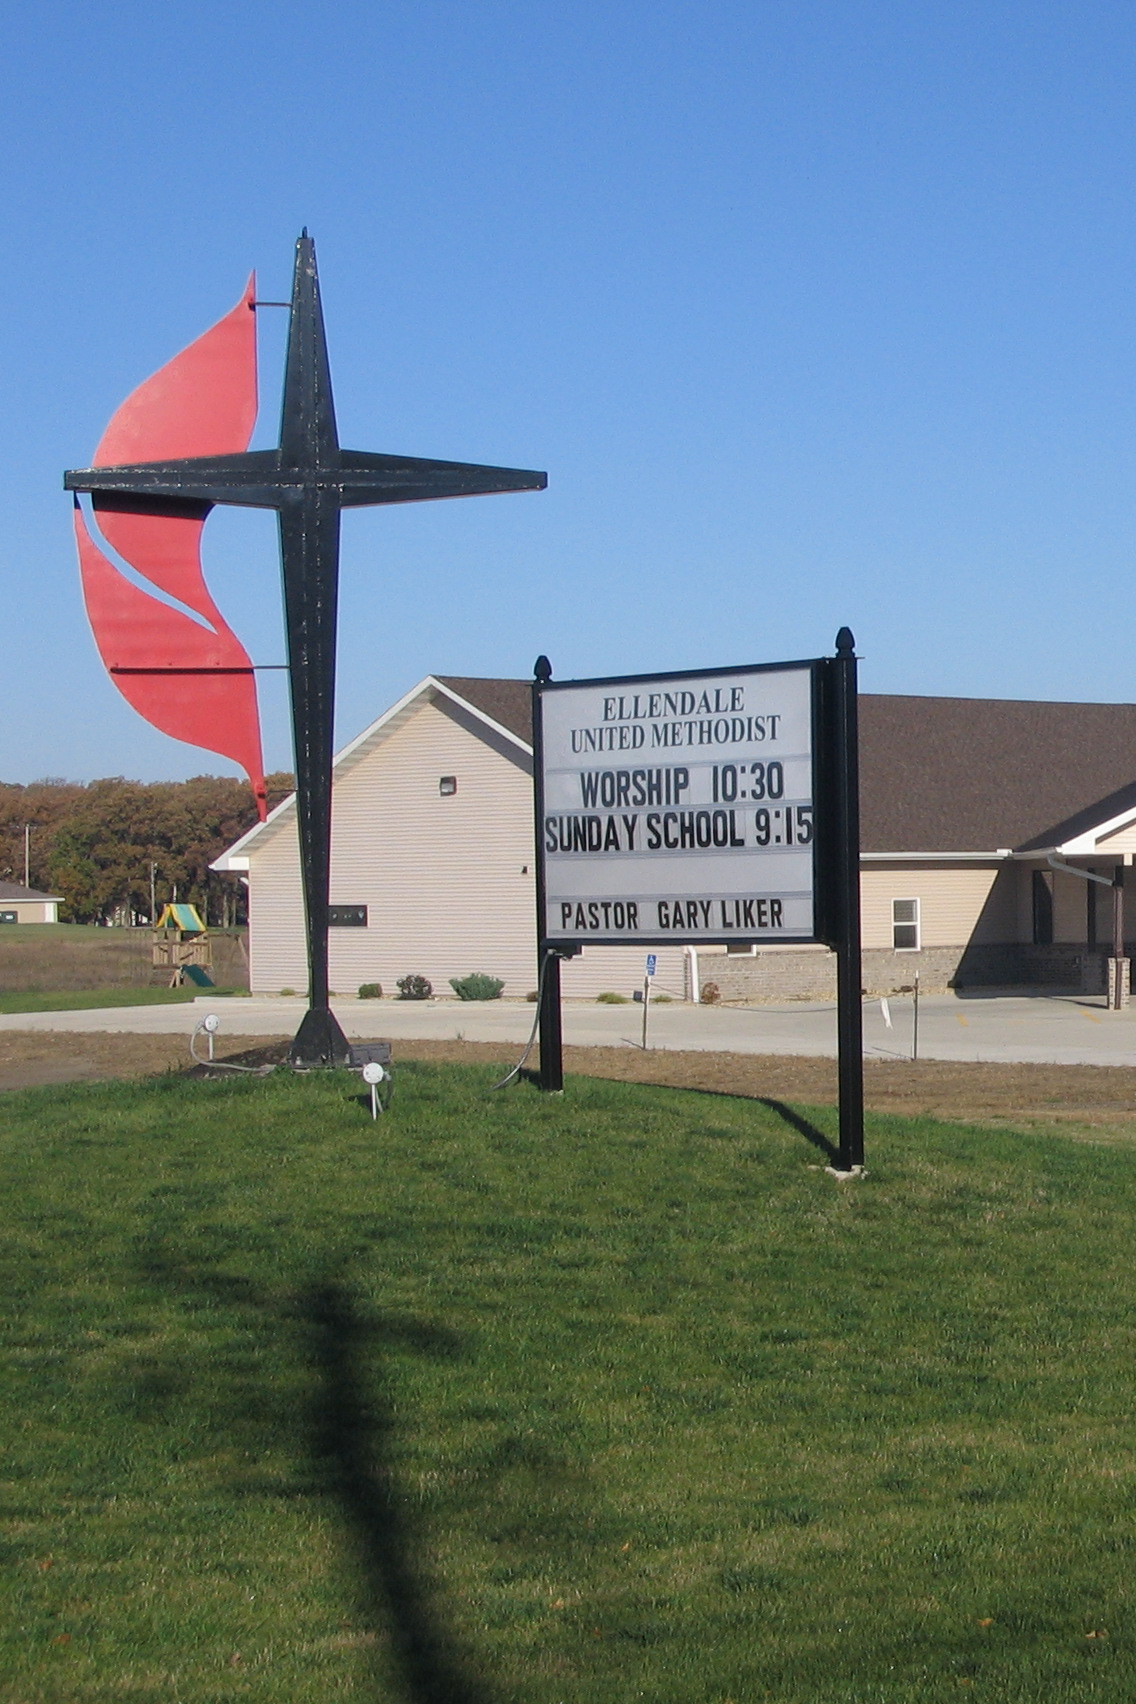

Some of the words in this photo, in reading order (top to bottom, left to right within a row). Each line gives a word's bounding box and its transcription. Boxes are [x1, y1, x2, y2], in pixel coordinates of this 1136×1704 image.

[602, 686, 745, 722] ELLENDALE
[570, 724, 645, 754] UNITED
[650, 714, 781, 749] METHODIST
[580, 766, 689, 808] WORSHIP
[712, 761, 784, 803] 10:30
[545, 814, 638, 852] SUNDAY
[646, 809, 745, 849] SCHOOL
[755, 805, 813, 845] 9:15
[561, 901, 638, 930] PASTOR
[657, 899, 713, 929] GARY
[721, 898, 783, 928] LIKER
